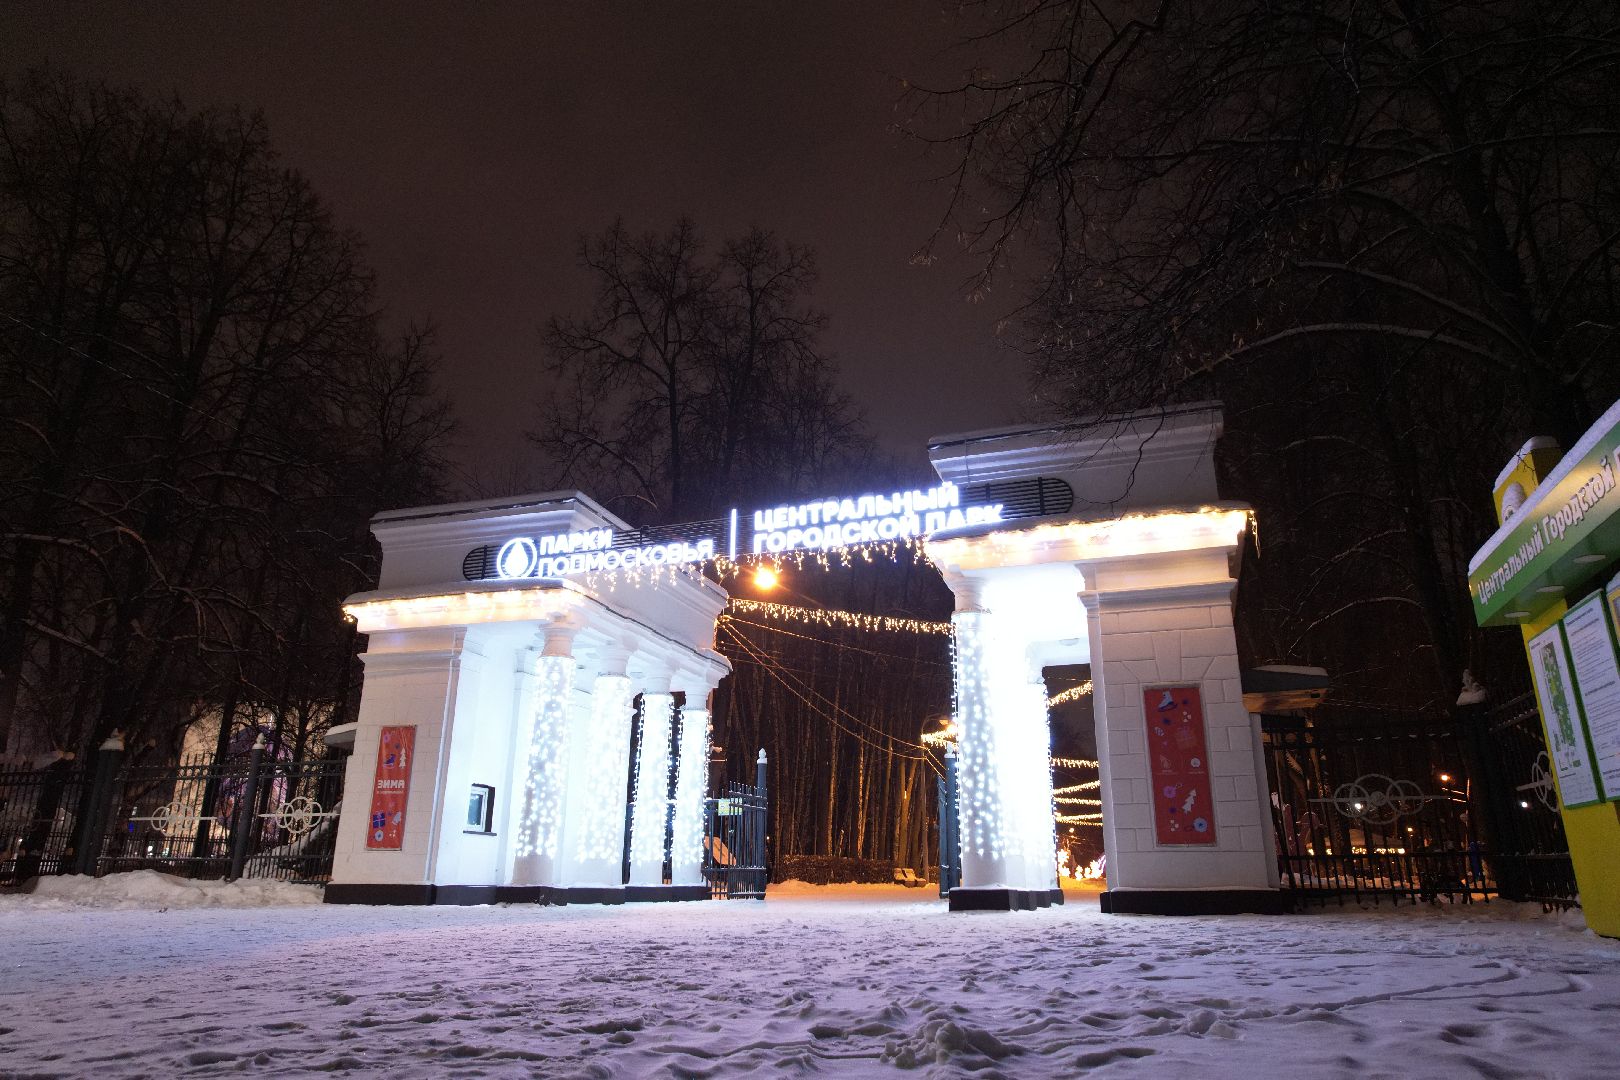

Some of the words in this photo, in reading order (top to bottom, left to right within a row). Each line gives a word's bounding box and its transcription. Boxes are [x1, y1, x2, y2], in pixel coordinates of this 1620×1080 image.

[753, 511, 920, 553] ГОРОДСКОЙ
[924, 504, 1004, 532] ПАРК
[754, 481, 960, 533] ЦЕНТРАЛЬНЫЙ
[540, 529, 613, 555] ПАРКИ
[1478, 524, 1544, 606] Центральный
[1542, 455, 1617, 546] Городской
[538, 539, 714, 578] ПОДМОСКОВЬЯ
[377, 779, 406, 789] ЗИМА
